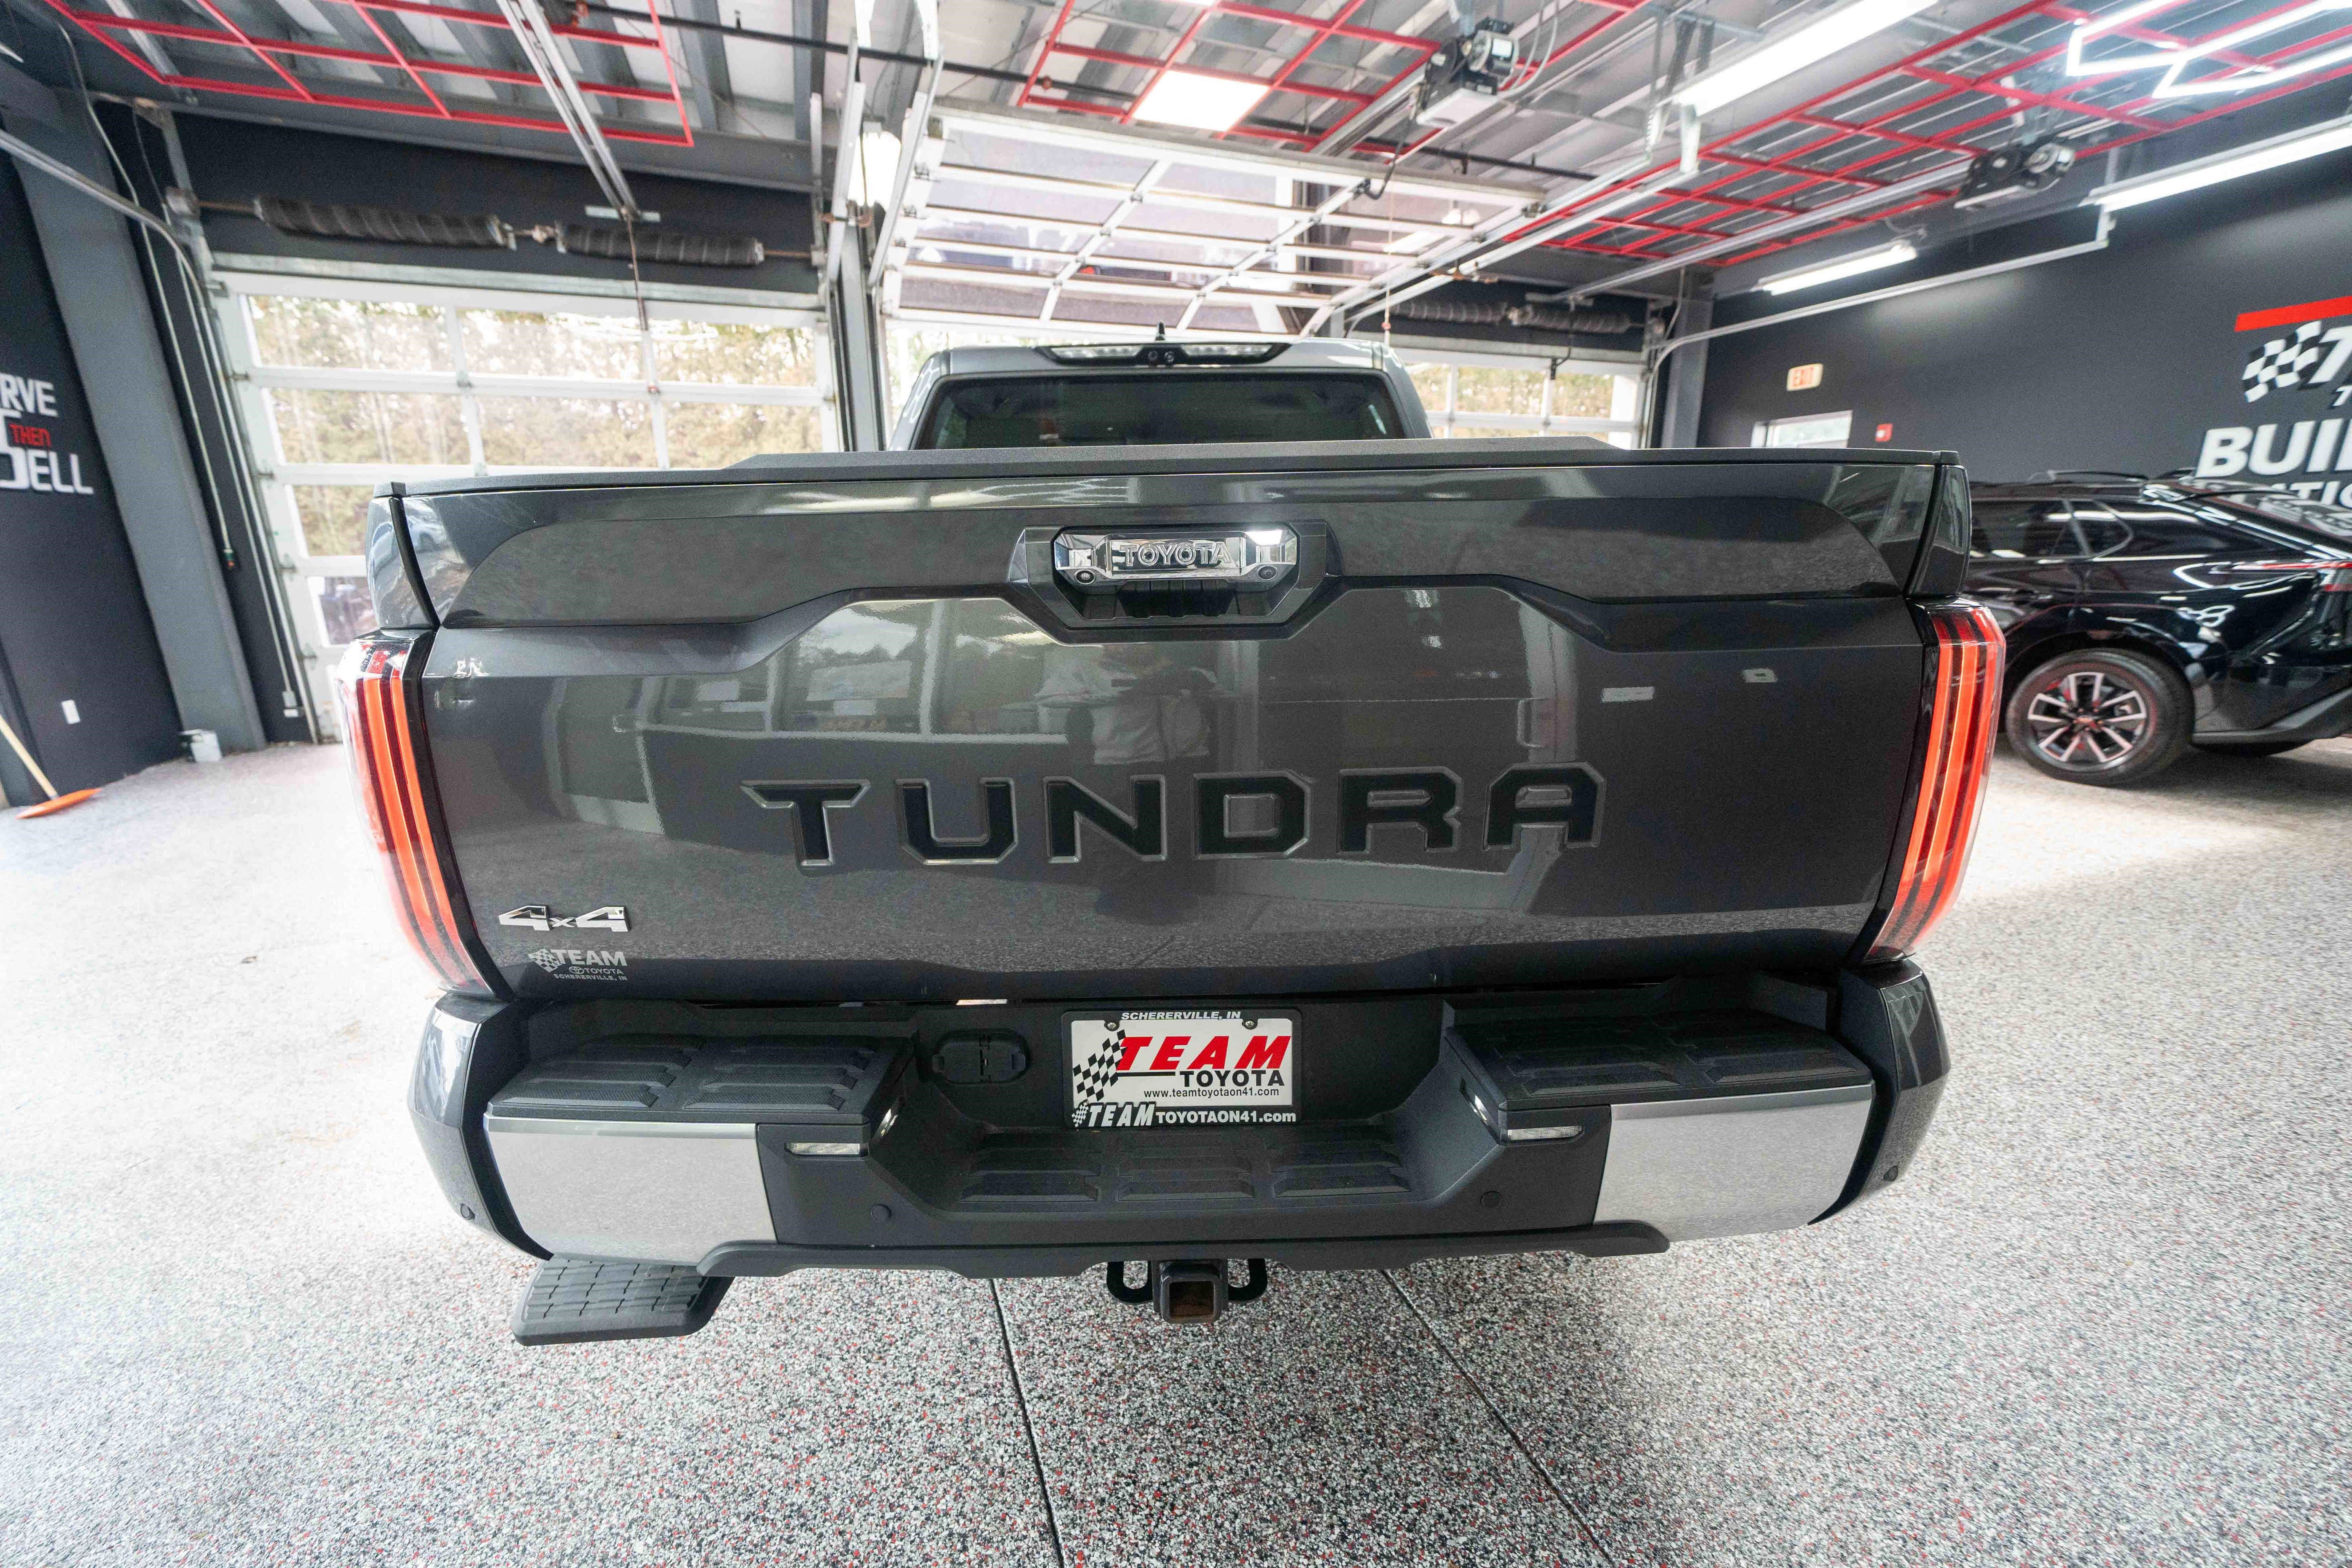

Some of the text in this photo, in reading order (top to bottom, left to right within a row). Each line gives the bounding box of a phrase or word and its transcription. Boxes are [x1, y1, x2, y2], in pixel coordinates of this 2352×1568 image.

[1119, 541, 1231, 567] TOYOTA
[740, 761, 1607, 867] TUNDRA
[551, 949, 628, 966] TEAM
[1121, 1011, 1241, 1020] SCHERERVILLE, IN
[1116, 1036, 1291, 1071] TEAM
[1179, 1070, 1285, 1087] TOYOTA
[1144, 1087, 1279, 1098] www.teamtoyotaon41.com
[1088, 1103, 1296, 1127] TEAM TOYOTAON41.com
